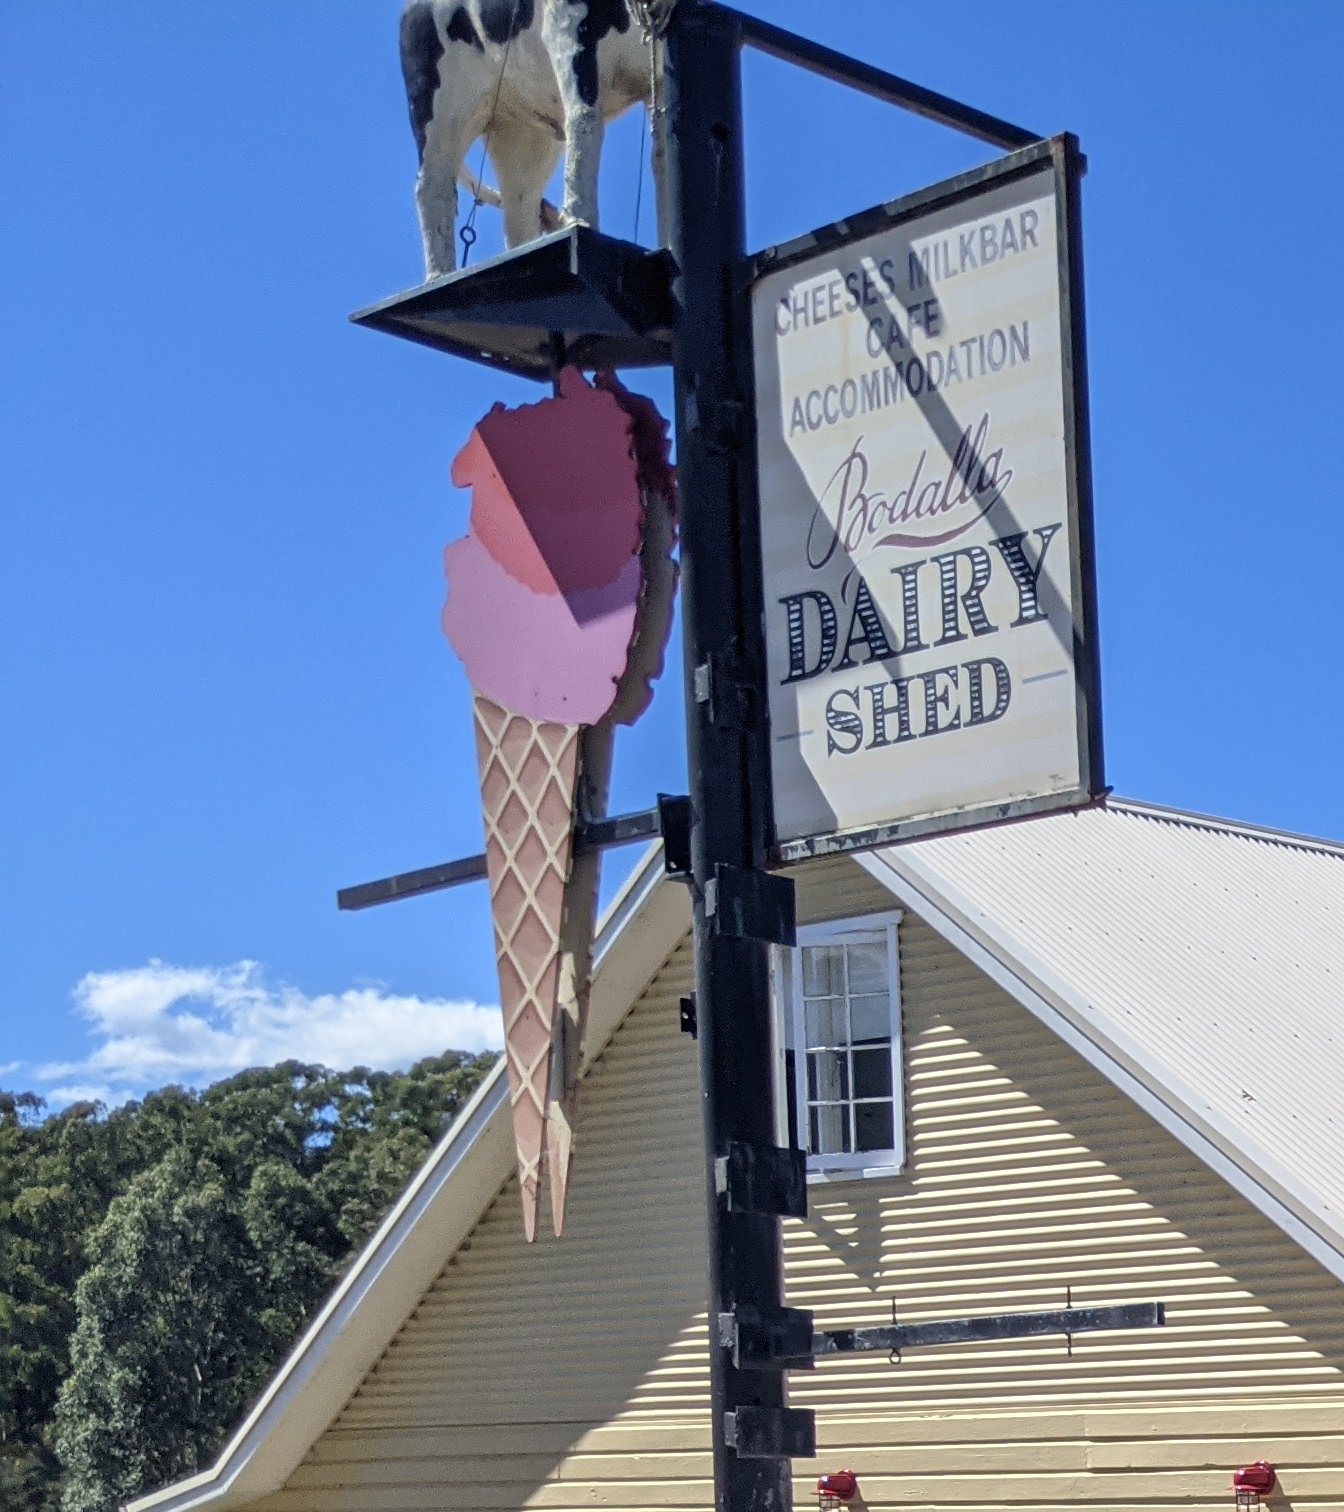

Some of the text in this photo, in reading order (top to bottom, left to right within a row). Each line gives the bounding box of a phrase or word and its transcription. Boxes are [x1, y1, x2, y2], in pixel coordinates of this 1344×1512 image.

[775, 210, 1039, 337] CHEESES MILKBAR
[866, 299, 941, 359] CAFE
[789, 320, 1031, 438] ACCOMMODATION
[807, 413, 1013, 569] Bodalla
[779, 523, 1063, 685] DAIRY
[825, 656, 1012, 759] SHED
